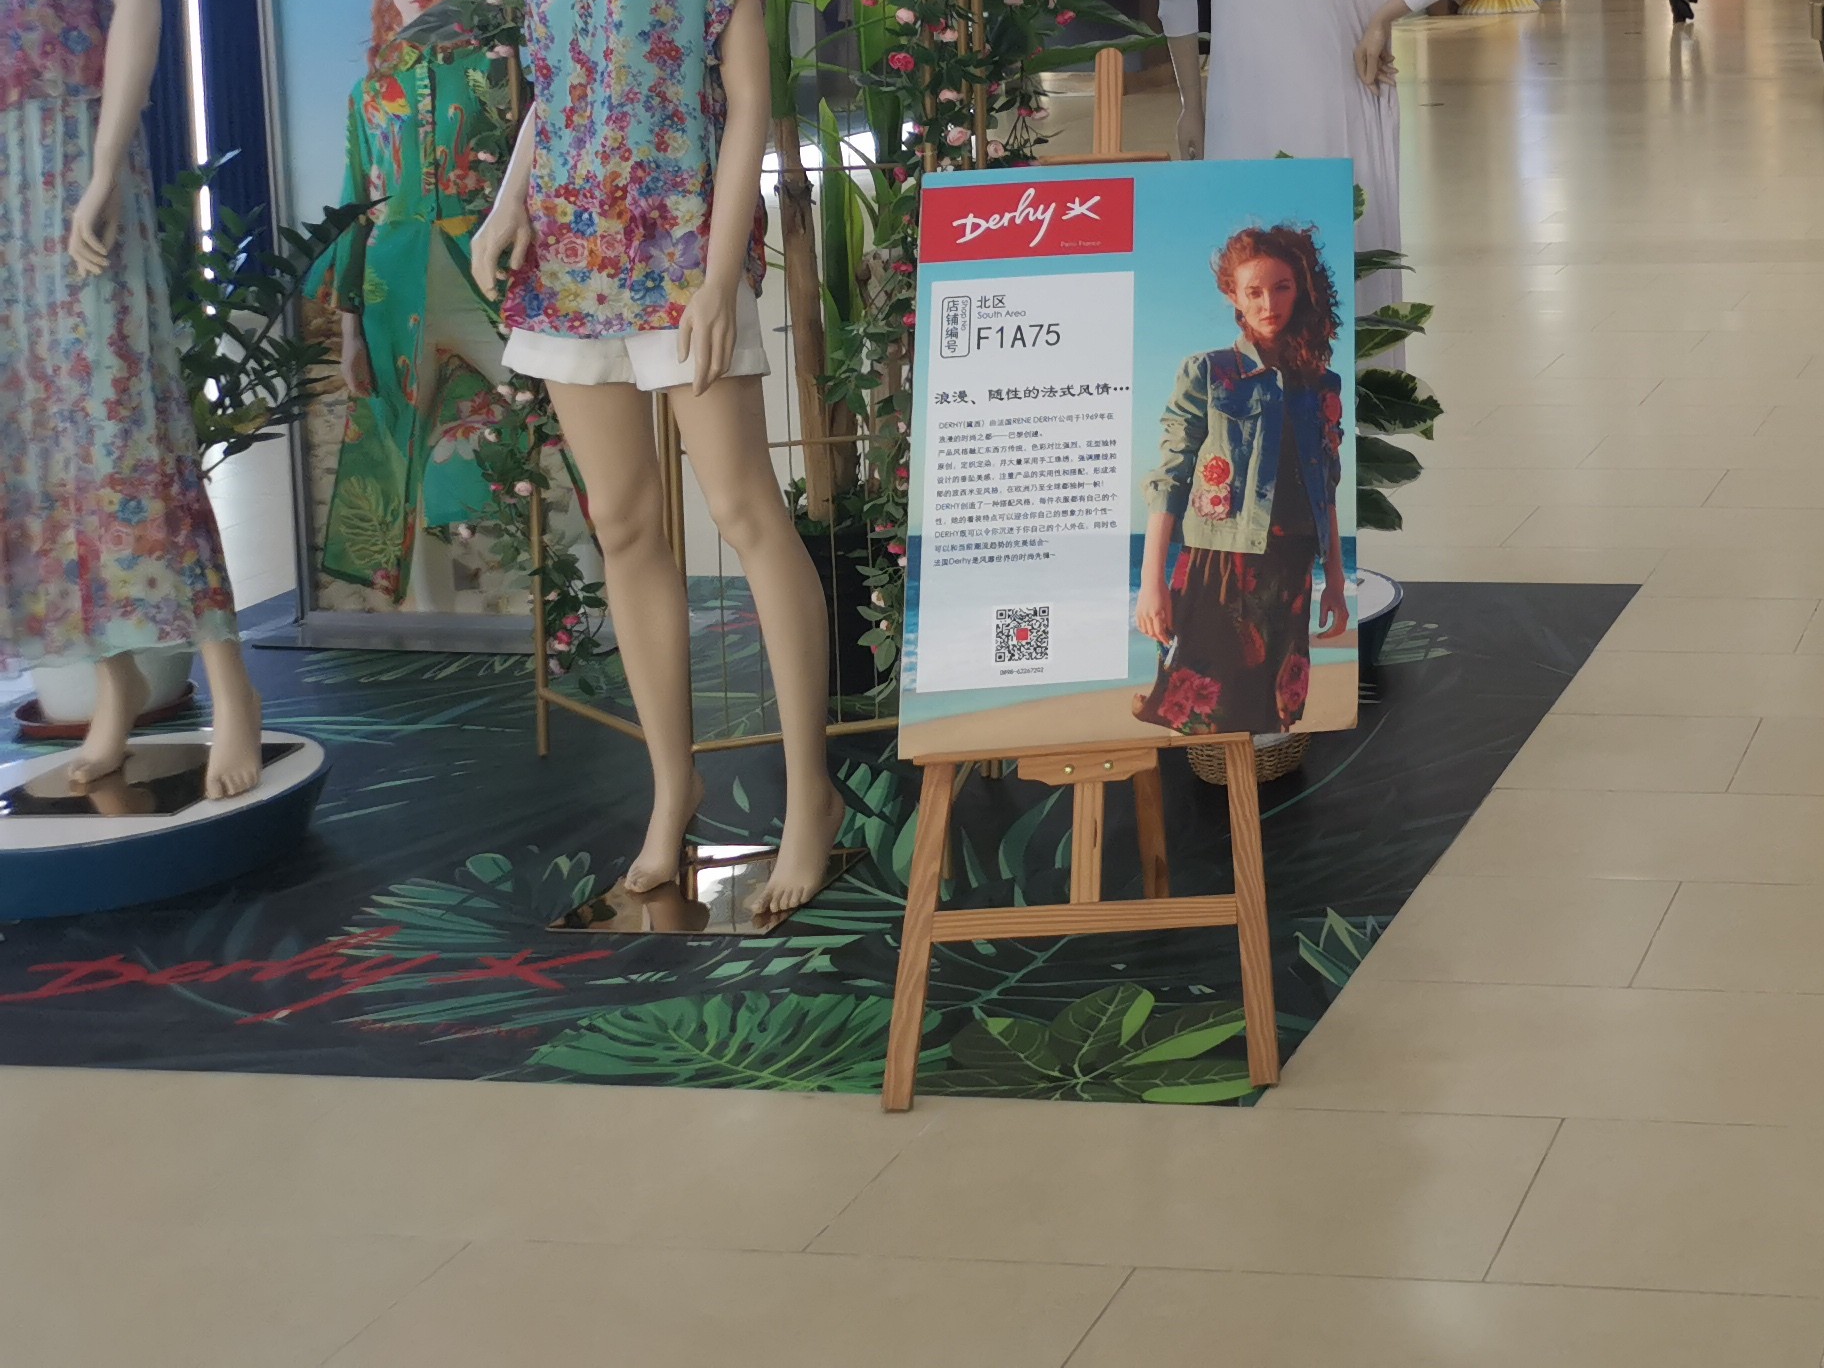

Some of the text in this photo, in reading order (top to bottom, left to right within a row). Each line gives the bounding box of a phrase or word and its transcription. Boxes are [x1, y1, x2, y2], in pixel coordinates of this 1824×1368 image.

[952, 187, 1057, 248] Derhy
[976, 295, 1006, 309] 北区
[976, 309, 1027, 320] South Area
[945, 299, 959, 354] 店铺编号
[976, 323, 1061, 350] F1A75
